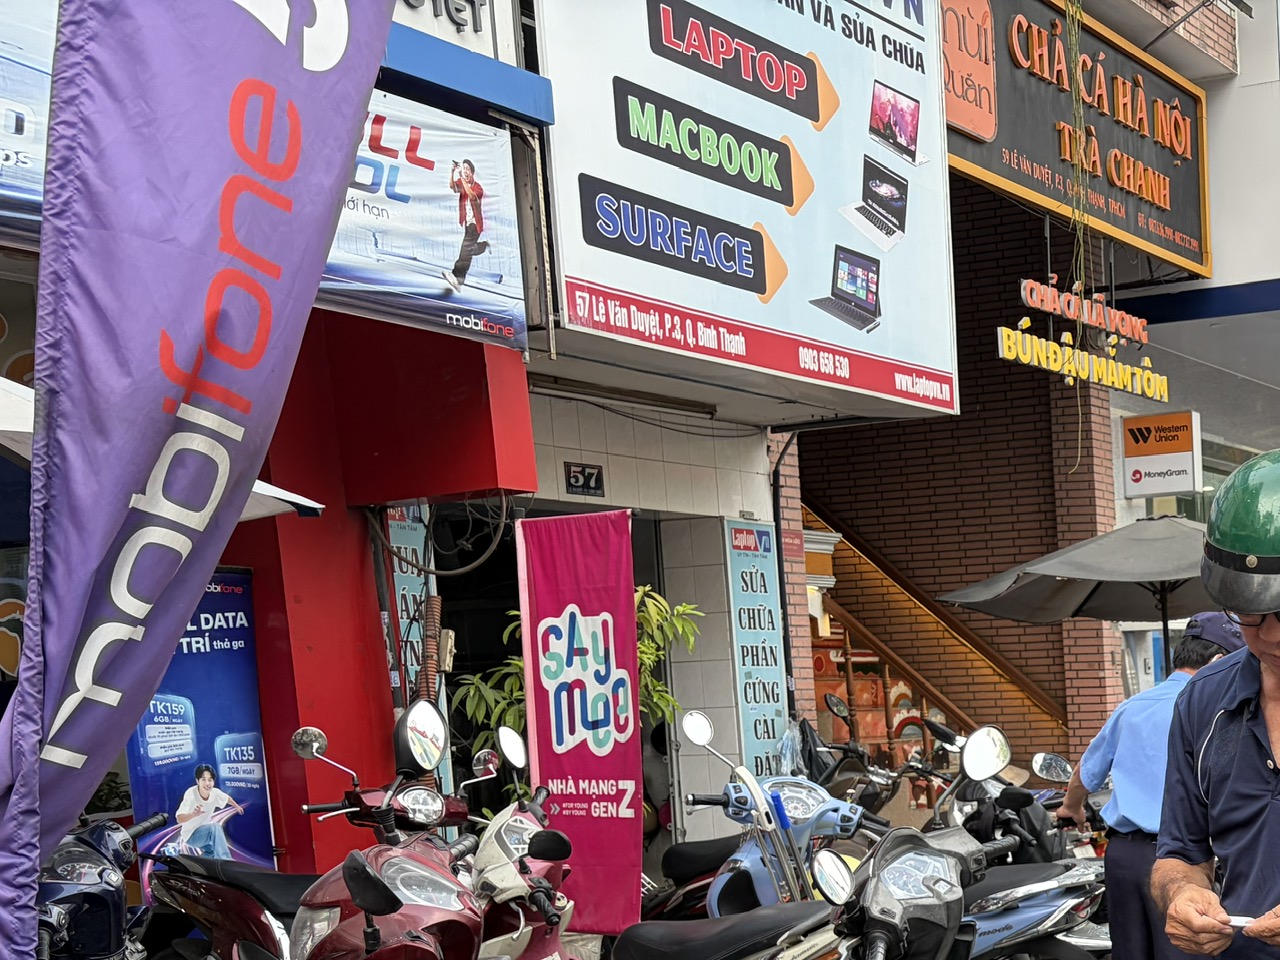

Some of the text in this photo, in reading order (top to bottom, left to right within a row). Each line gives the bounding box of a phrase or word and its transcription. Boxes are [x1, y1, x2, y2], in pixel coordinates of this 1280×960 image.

[660, 4, 808, 100] LAPTOP
[840, 12, 876, 52] SỬA
[881, 34, 926, 75] CHỮA
[1008, 14, 1193, 166] CHẢ CÁ HÀ NỘI
[363, 112, 436, 171] LL
[627, 97, 782, 192] MACBOOK
[1056, 121, 1171, 211] TRÀ CHANH
[362, 203, 390, 220] hạn
[595, 193, 755, 278] SURFACE
[575, 290, 590, 318] 57
[592, 294, 605, 323] Lê
[607, 299, 628, 329] Văn
[630, 305, 663, 341] Duyệt,
[664, 312, 684, 345] P.3,
[685, 319, 696, 348] Q.
[719, 327, 746, 357] Thạnh
[1020, 273, 1062, 315] CHẢ
[1106, 307, 1148, 346] VỌNG
[445, 312, 515, 339] mobifone
[799, 346, 850, 379] 0903 658 530
[997, 316, 1169, 403] BÚN ĐẬU MẮM TÔM
[1153, 425, 1189, 434] Western
[1154, 434, 1179, 443] Union
[570, 466, 599, 488] 57
[205, 582, 243, 594] obifone
[740, 564, 768, 594] SỬA
[199, 611, 249, 630] DATA
[738, 604, 776, 631] CHỮA
[179, 632, 245, 654] TRÍ thả ga
[740, 638, 778, 667] PHẦN
[743, 677, 780, 705] CỨNG
[149, 700, 185, 716] TK159
[754, 713, 777, 740] CÀI
[223, 746, 255, 761] TK135
[548, 775, 617, 799] NHÀ MẠNG
[618, 779, 636, 818] Z
[591, 801, 617, 818] GEN
